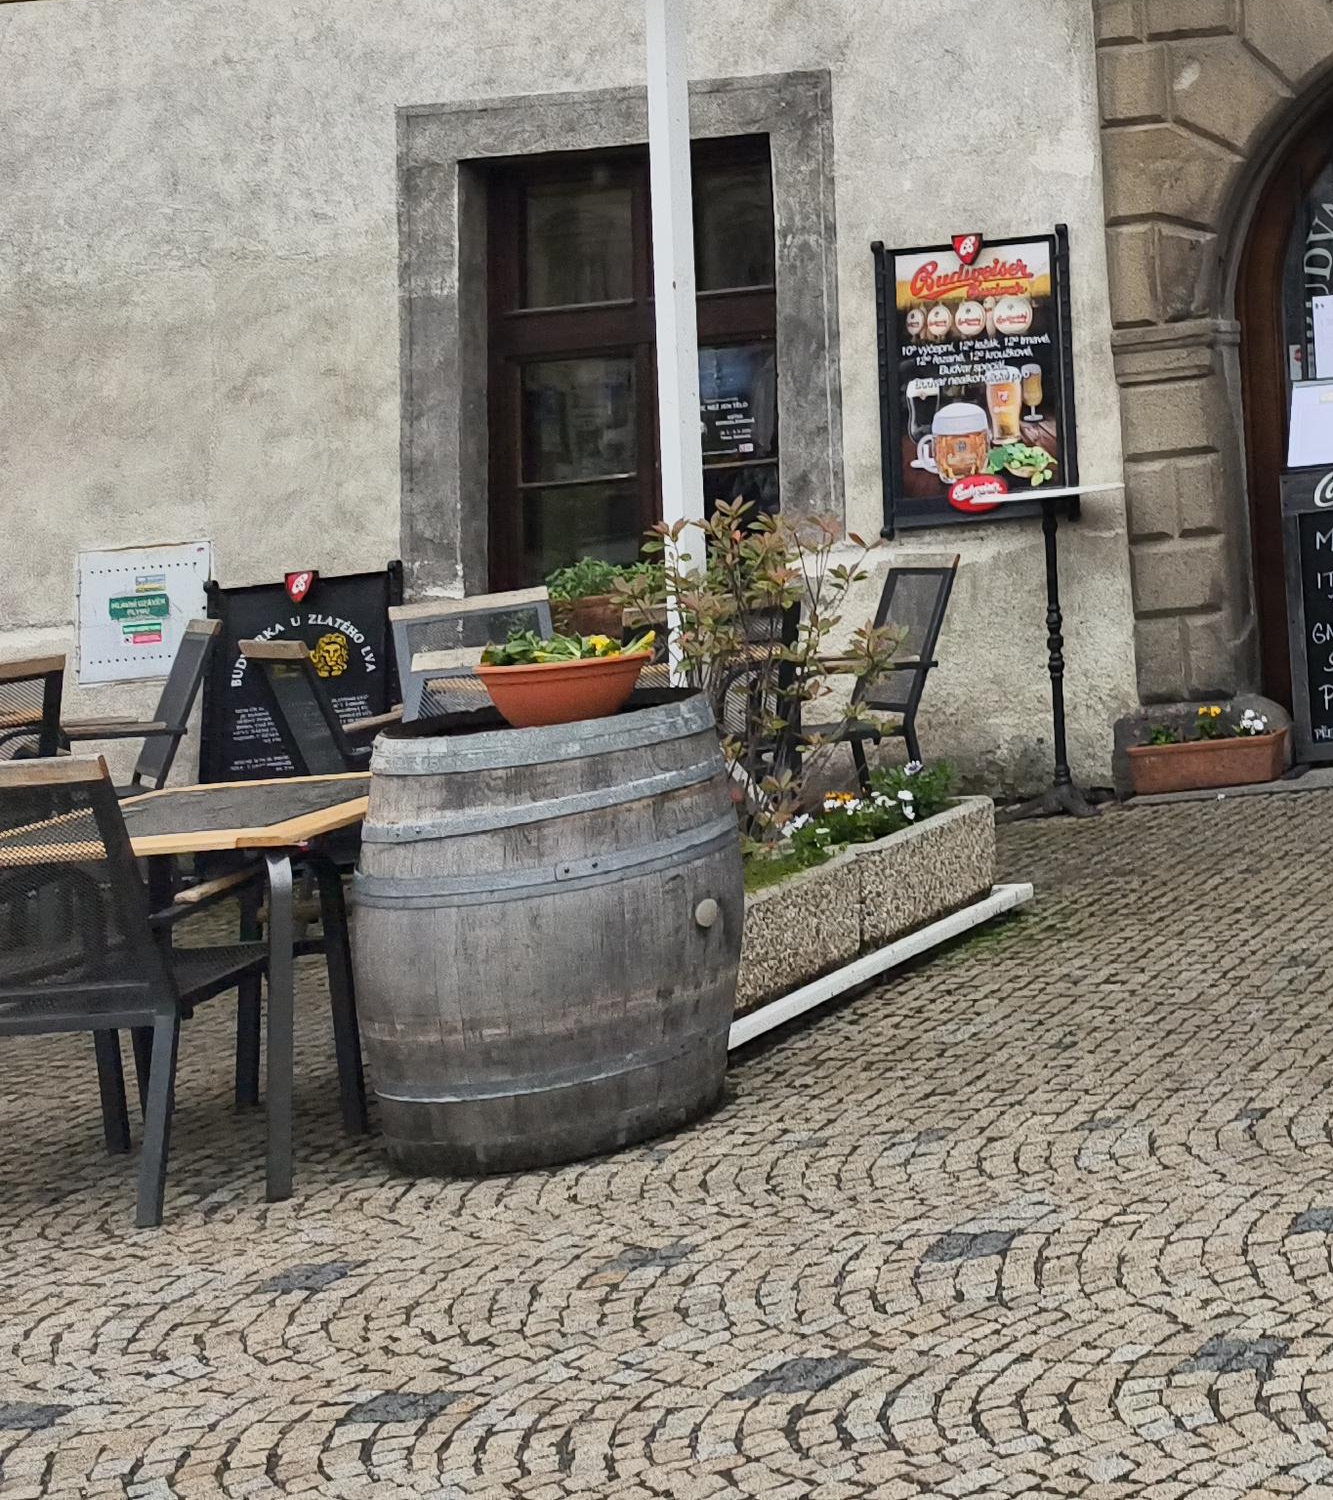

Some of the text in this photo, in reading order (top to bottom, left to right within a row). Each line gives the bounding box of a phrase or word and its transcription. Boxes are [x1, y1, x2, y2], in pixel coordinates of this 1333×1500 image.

[910, 258, 1034, 300] Budweiser
[231, 614, 377, 688] BUDRKA U ZLATÉHO LVA
